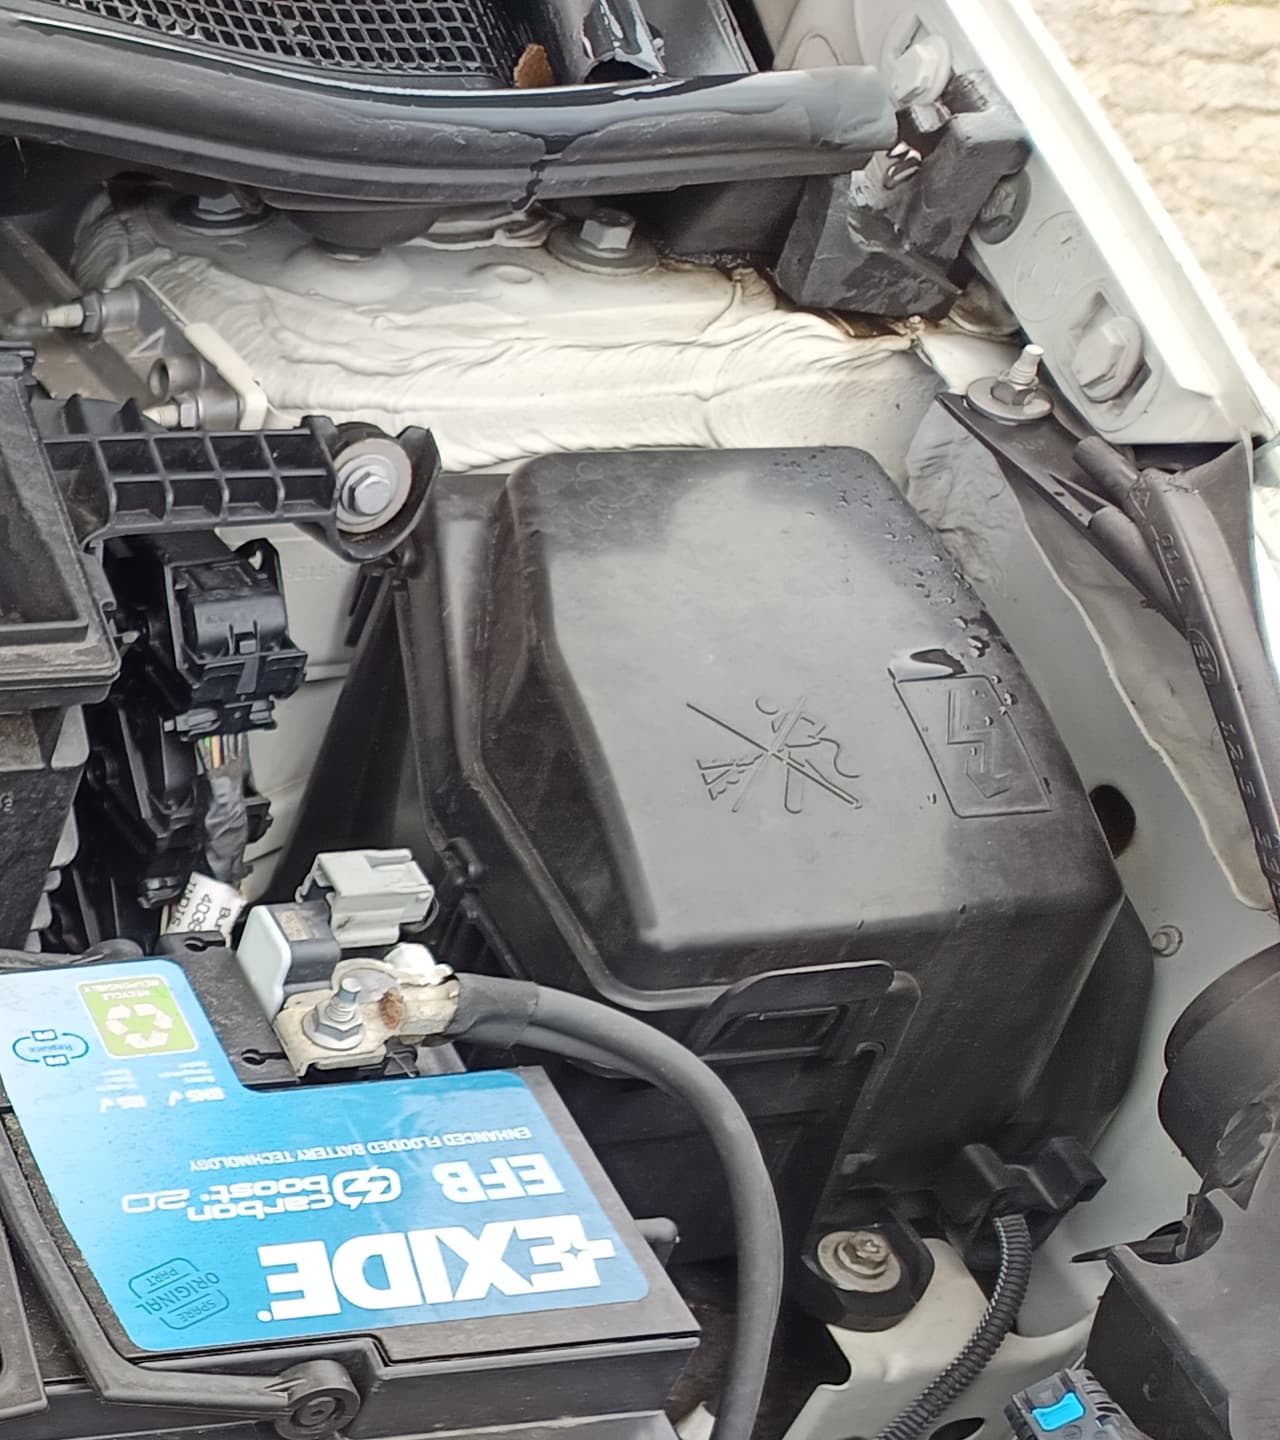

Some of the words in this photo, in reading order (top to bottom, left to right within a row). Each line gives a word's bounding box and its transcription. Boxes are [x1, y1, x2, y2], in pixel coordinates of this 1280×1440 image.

[369, 1134, 440, 1155] FLOODED
[442, 1126, 531, 1147] ENHANCED
[189, 1149, 296, 1173] TECHNOLOGY
[296, 1142, 367, 1163] BATTERY
[432, 1153, 565, 1203] EFB
[187, 1193, 334, 1223] carbon
[144, 1265, 179, 1287] PART
[258, 1215, 616, 1321] EXIDE
[135, 1270, 221, 1314] ORIGINAL
[179, 1294, 218, 1324] SPARE
